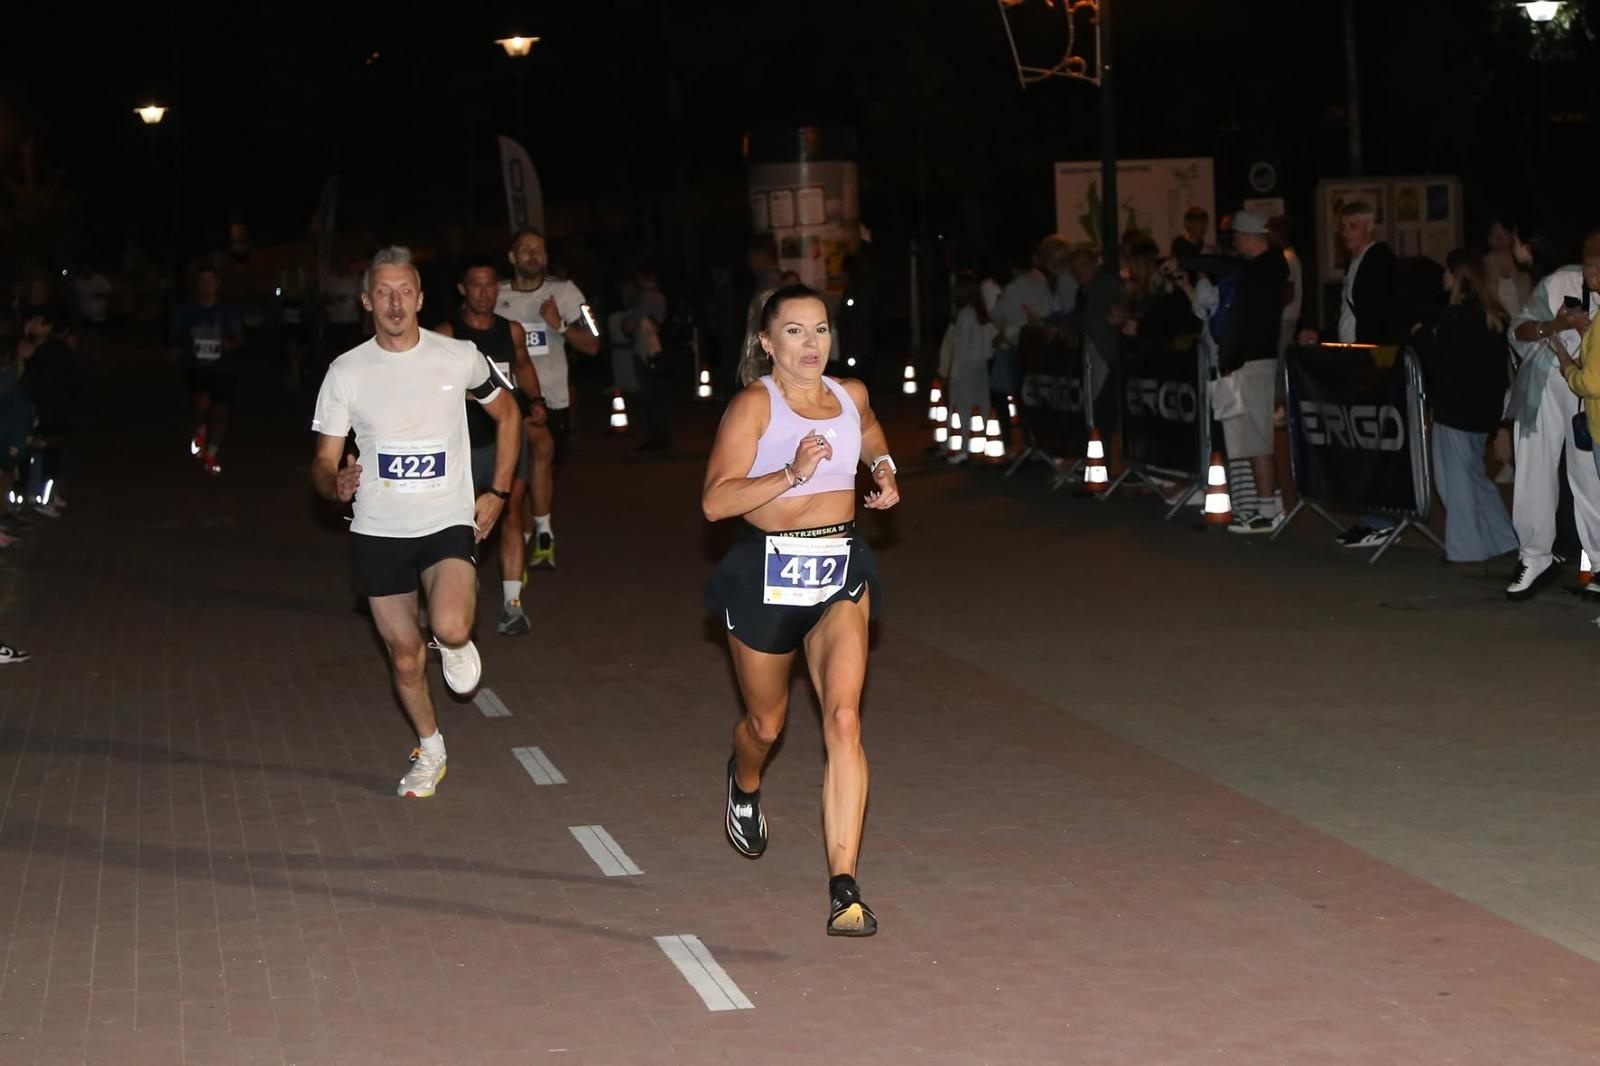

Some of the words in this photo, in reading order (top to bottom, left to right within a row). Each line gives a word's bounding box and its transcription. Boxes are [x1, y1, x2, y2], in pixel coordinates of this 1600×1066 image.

[1298, 400, 1405, 452] ERIGO
[388, 455, 436, 478] 422
[780, 557, 838, 586] 412
